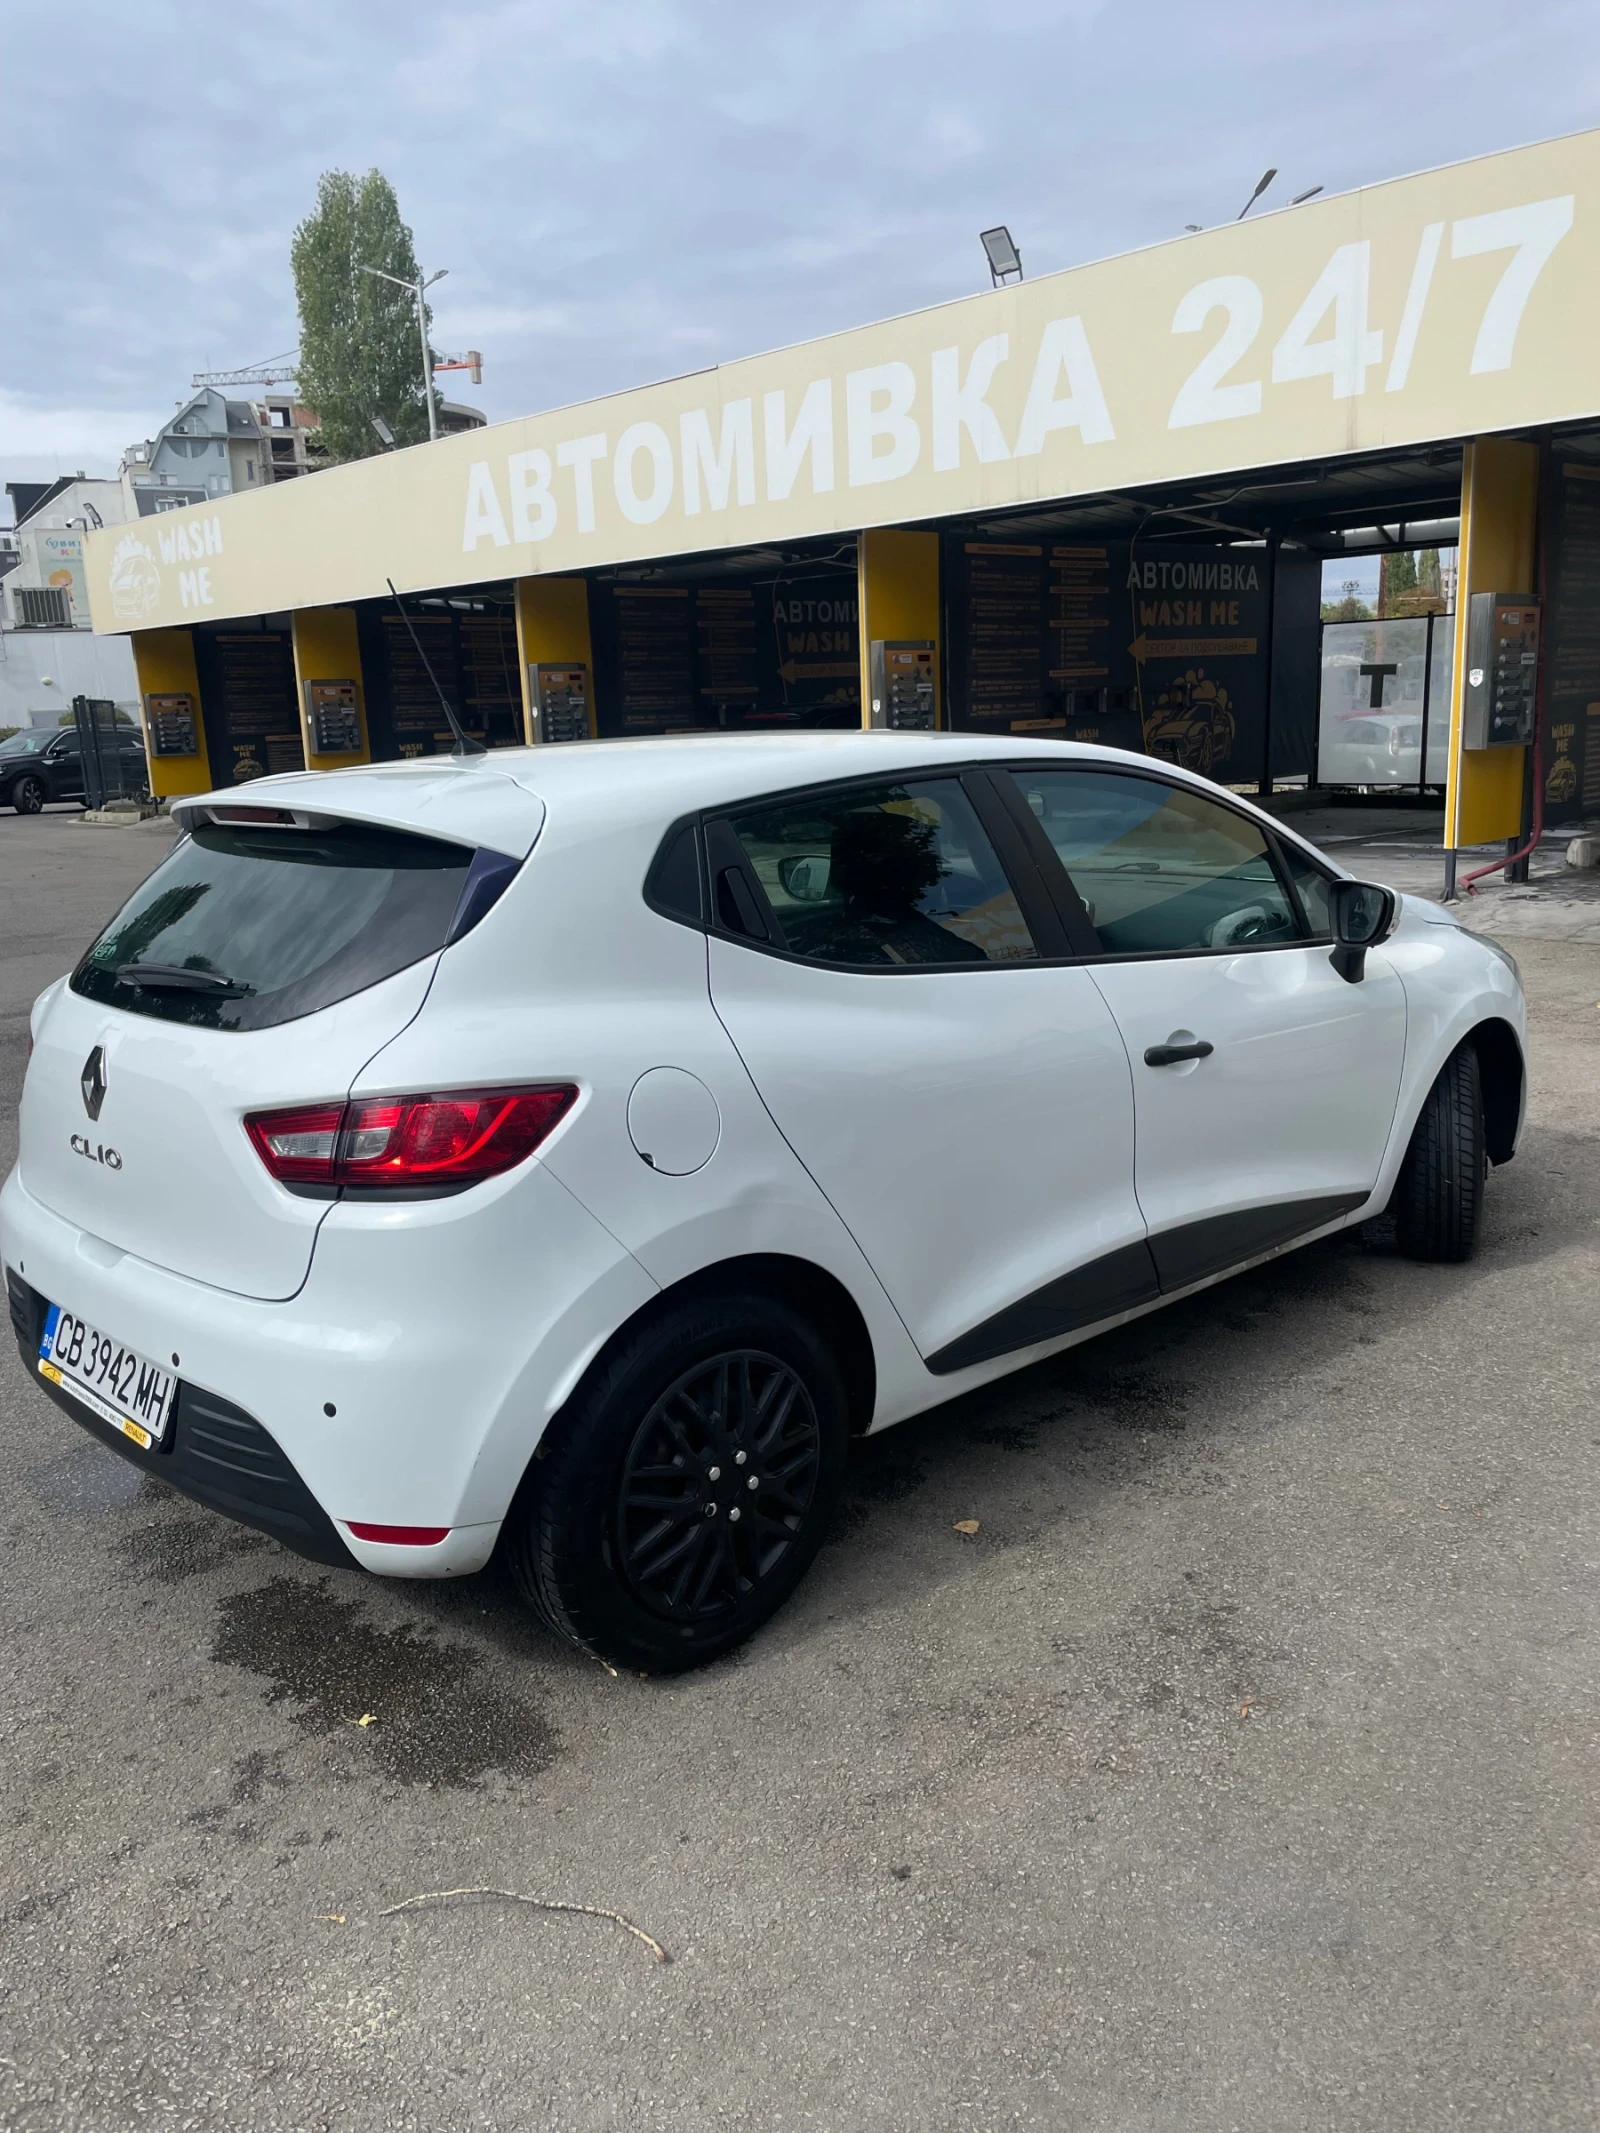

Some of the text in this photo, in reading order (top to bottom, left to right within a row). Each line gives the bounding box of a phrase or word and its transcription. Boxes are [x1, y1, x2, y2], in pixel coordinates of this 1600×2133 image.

[462, 194, 1575, 552] АВТОМИВКА 24/7
[157, 516, 223, 565] WASH
[179, 566, 215, 608] ME
[1126, 560, 1260, 591] АВТОМИВКА
[1139, 600, 1240, 627] WASH ME
[787, 631, 850, 653] WASH
[1144, 643, 1177, 654] СЕКТОР
[1551, 724, 1575, 739] WASH
[1556, 739, 1568, 753] ME
[71, 1134, 122, 1170] CLIO
[42, 1333, 53, 1349] BG
[55, 1313, 170, 1427] CB 3942 MH
[125, 1423, 146, 1442] RENAULT
